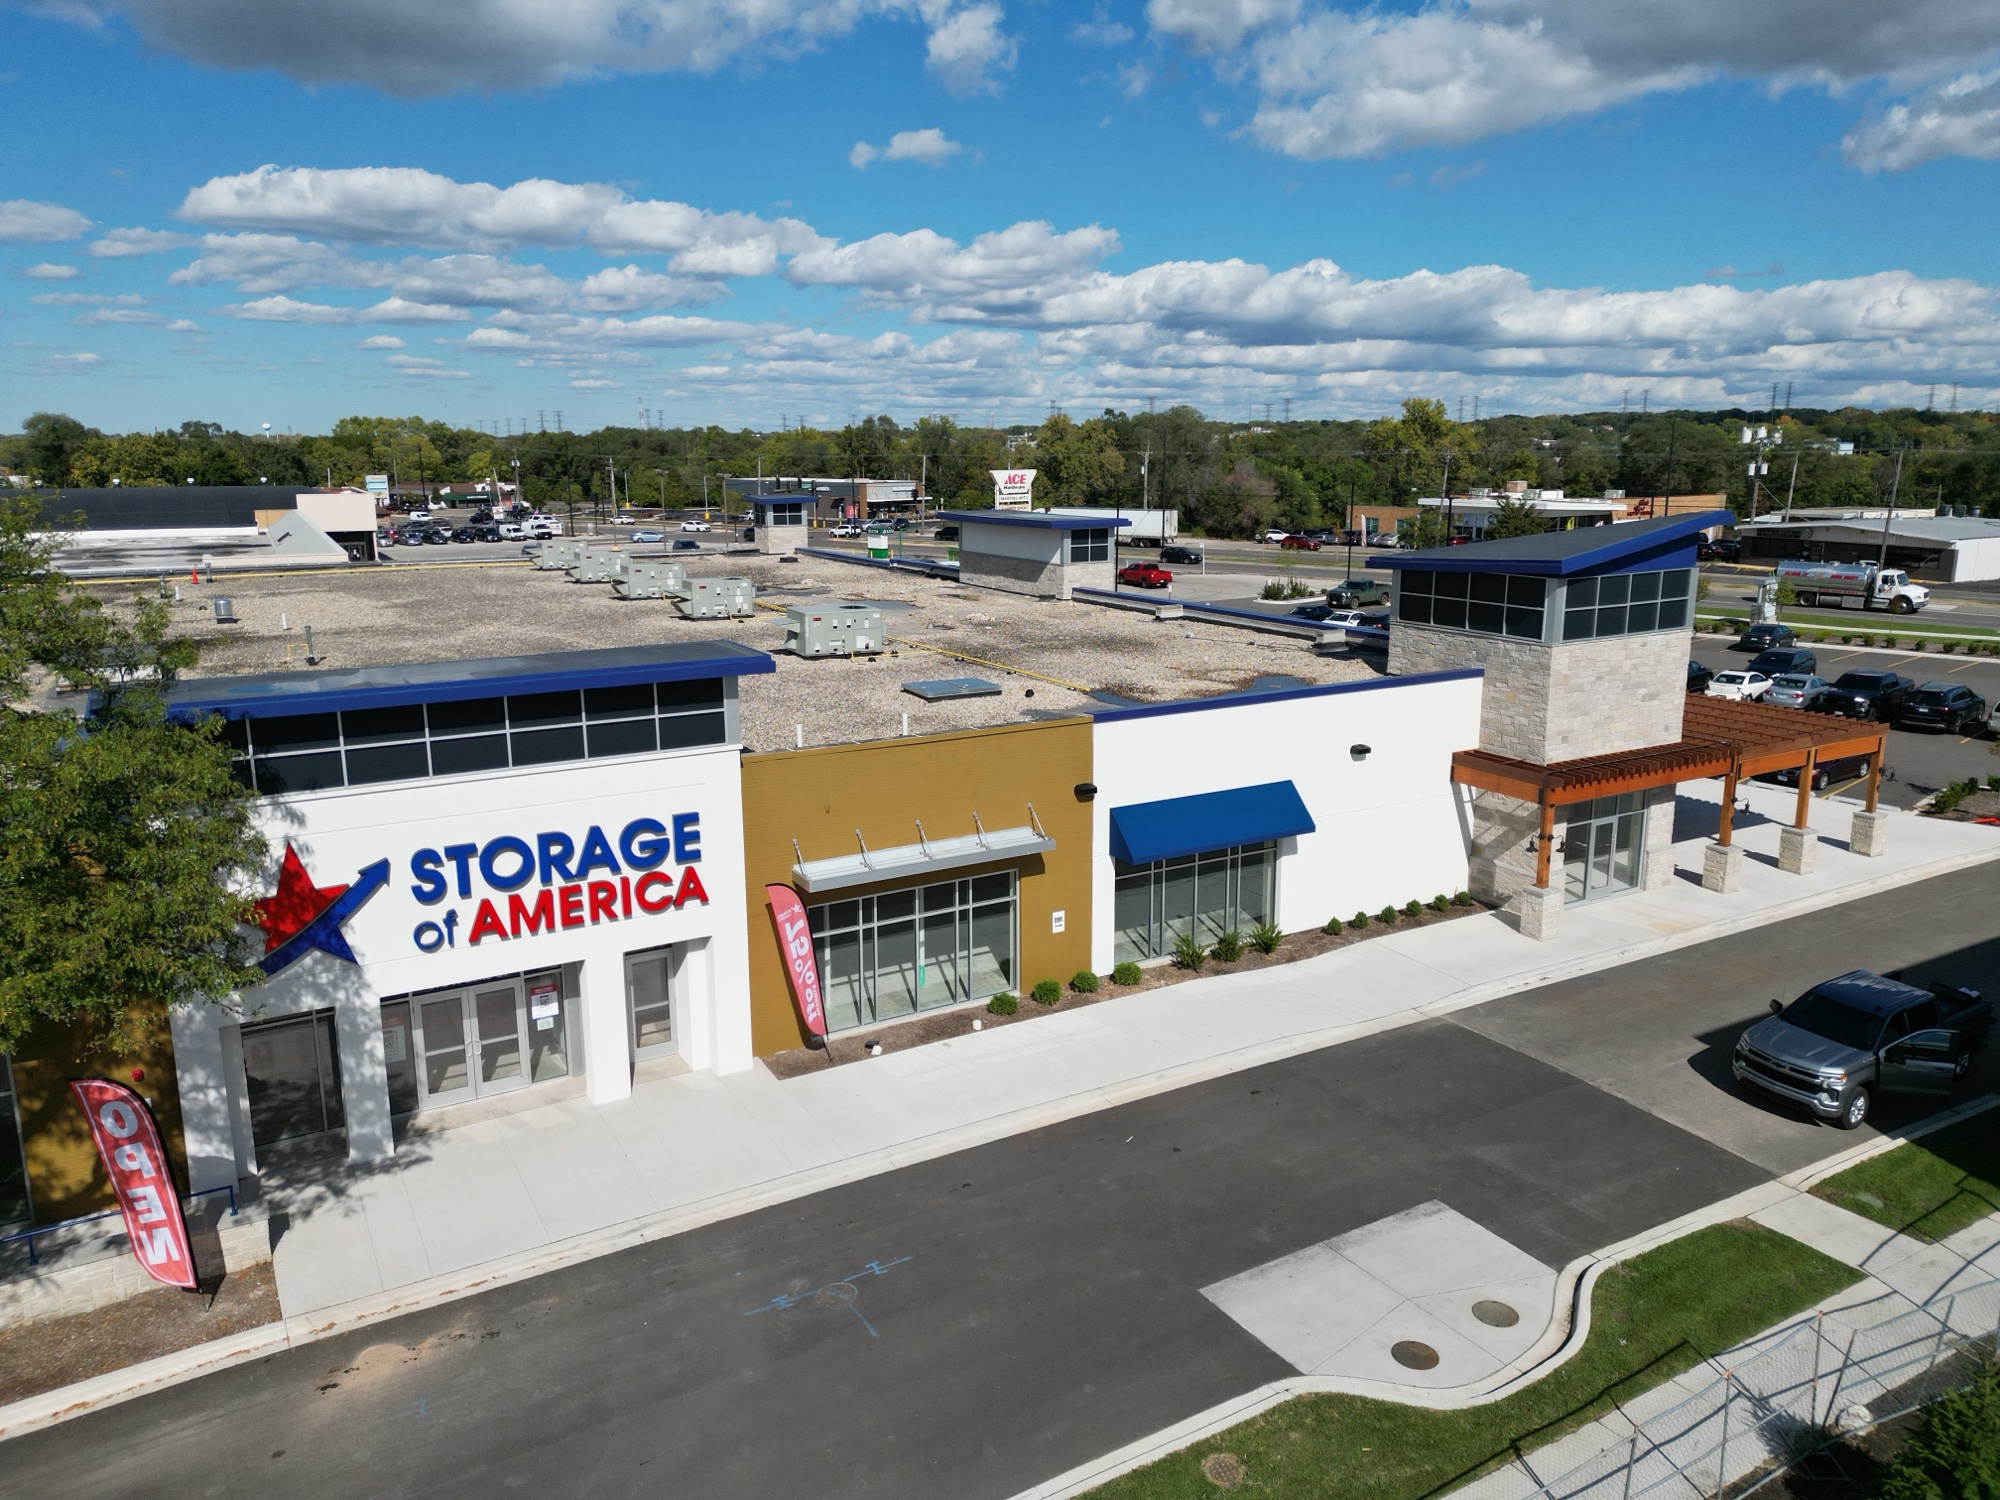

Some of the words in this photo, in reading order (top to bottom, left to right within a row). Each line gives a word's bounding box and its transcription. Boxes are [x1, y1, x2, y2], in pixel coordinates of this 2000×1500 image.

[1004, 473, 1027, 484] ACE
[410, 812, 703, 904] STORAGE
[413, 909, 458, 953] of
[468, 866, 709, 945] AMERICA
